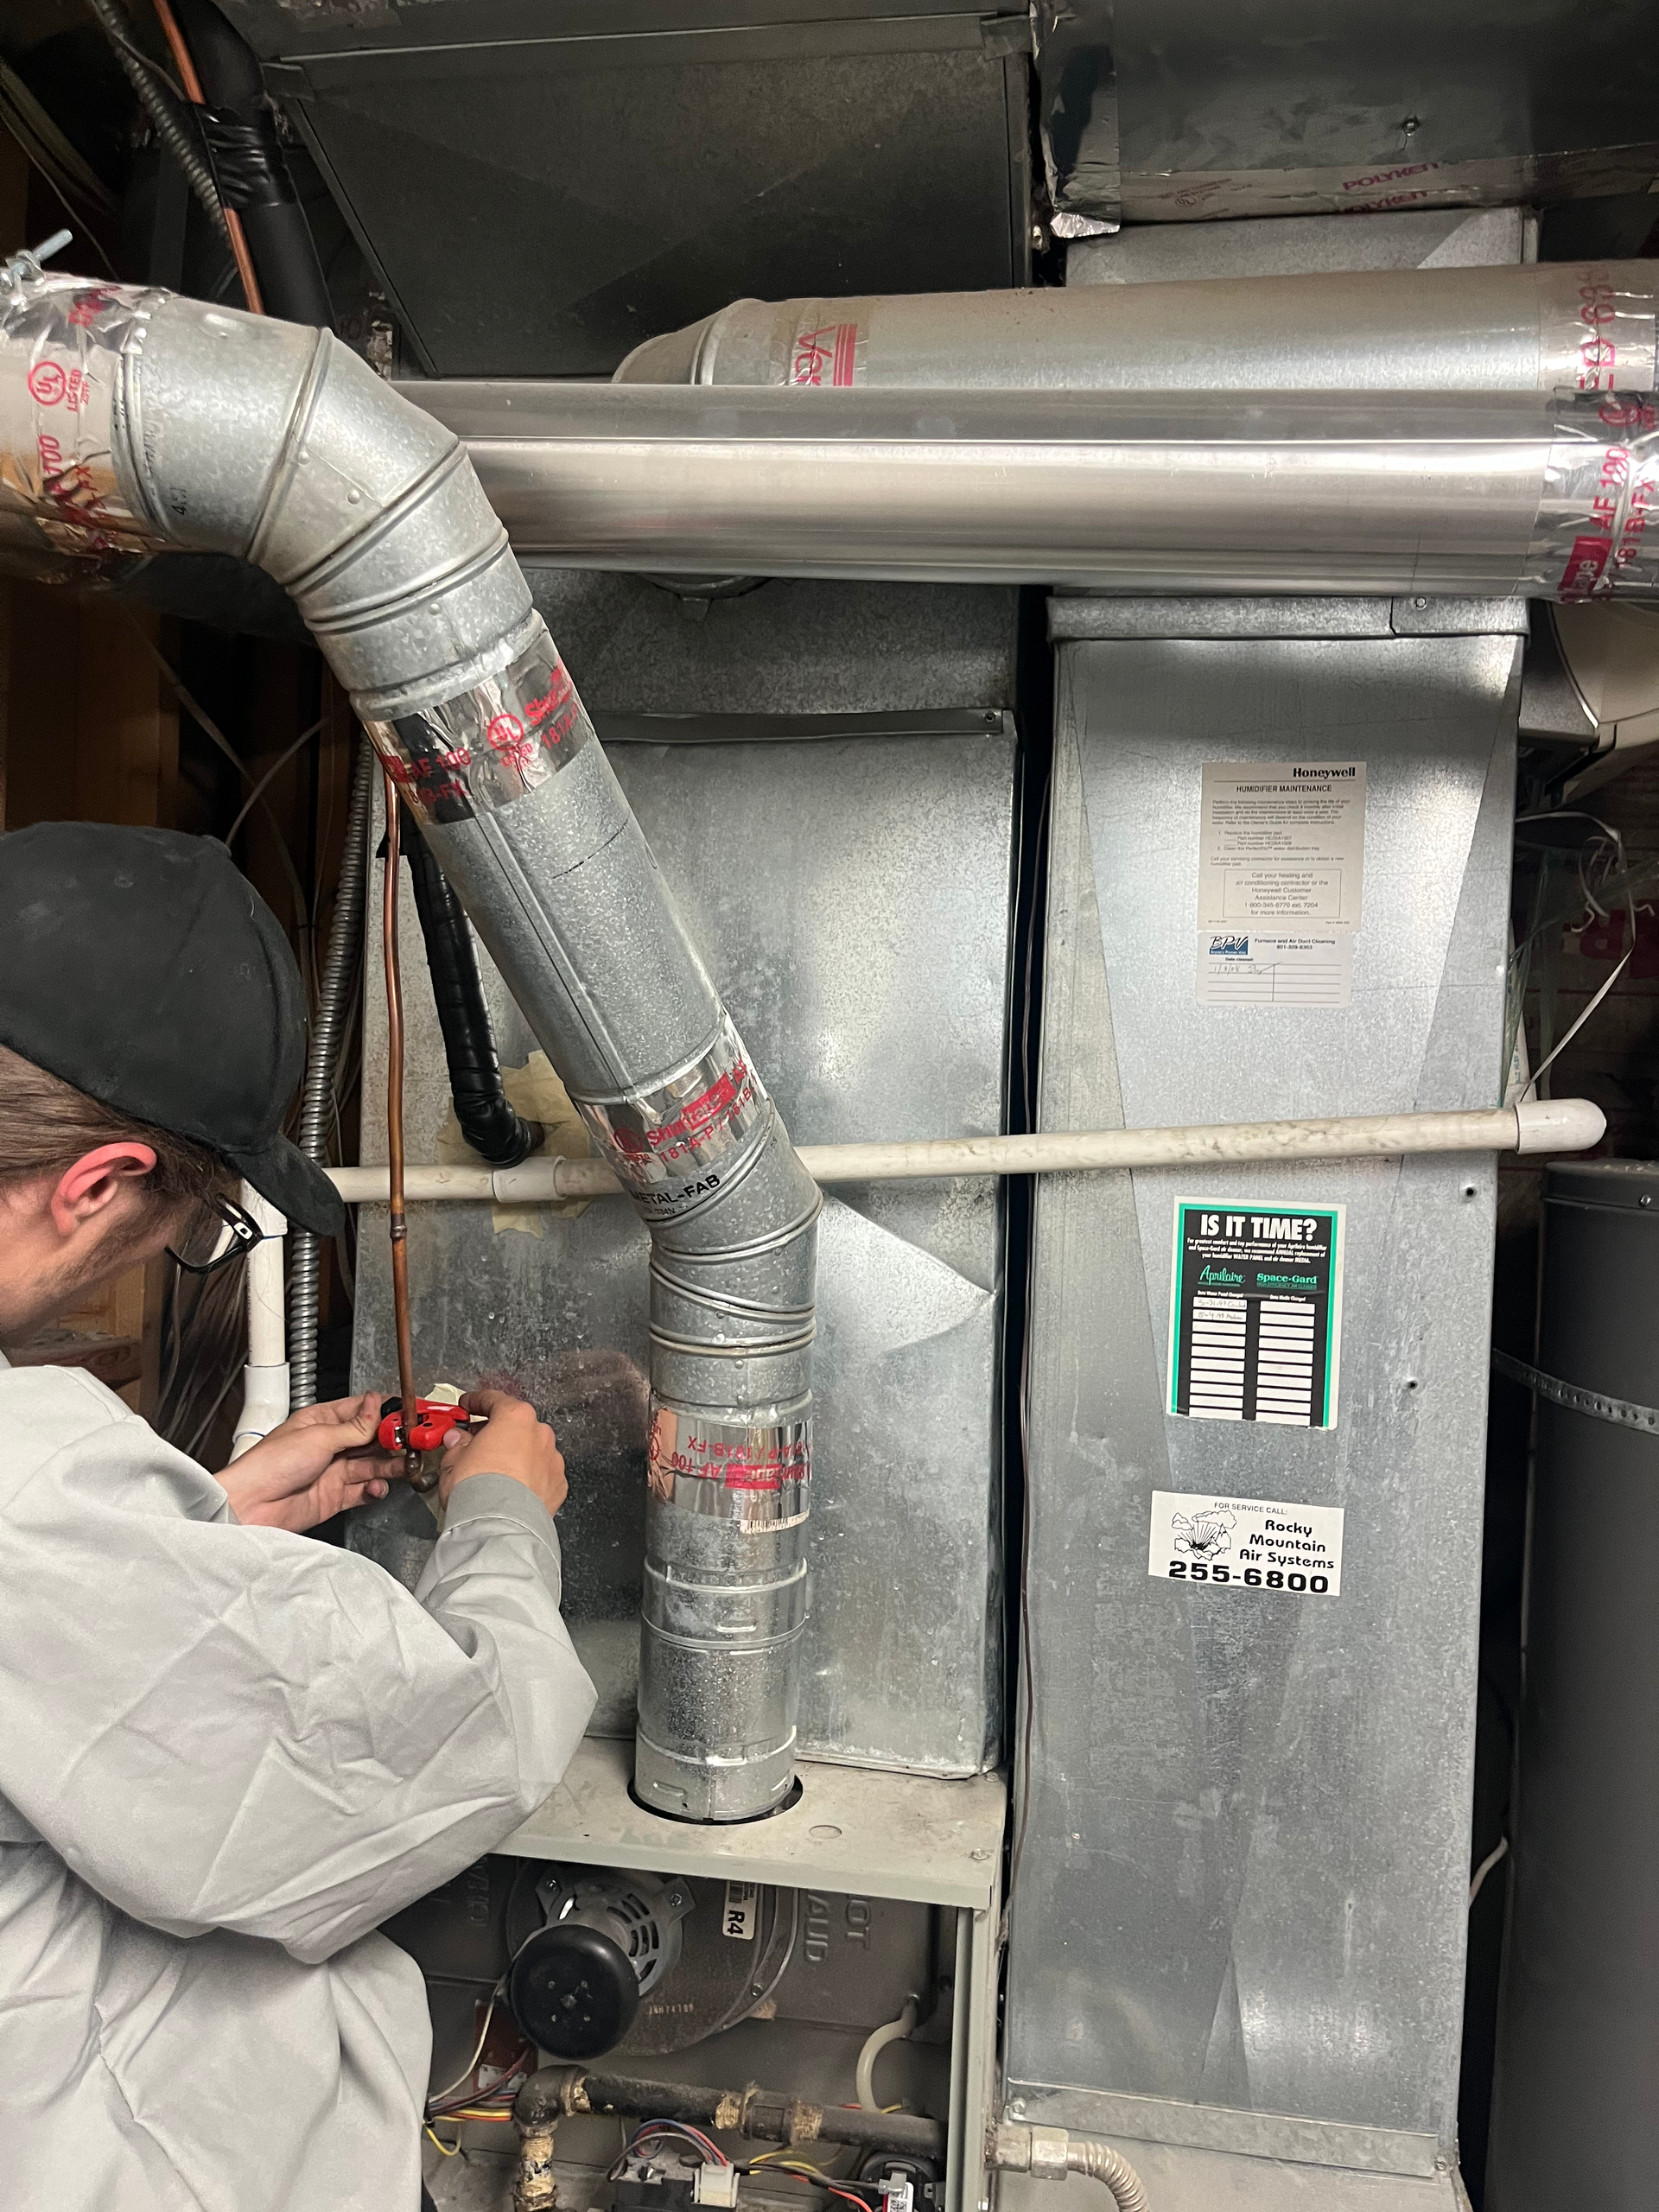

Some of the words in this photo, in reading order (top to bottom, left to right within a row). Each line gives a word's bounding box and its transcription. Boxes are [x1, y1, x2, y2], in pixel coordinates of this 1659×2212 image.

[1293, 767, 1356, 779] Honeywell
[1210, 936, 1249, 950] BPV
[1200, 1214, 1220, 1236] IS
[1225, 1216, 1246, 1237] IT
[1250, 1217, 1317, 1241] TIME?
[1199, 1264, 1246, 1286] Aprilaire
[1256, 1273, 1317, 1284] Space-Gard
[1231, 1503, 1264, 1513] SERVICE
[1265, 1519, 1313, 1537] Rocky
[1249, 1534, 1325, 1553] Mountain
[1239, 1548, 1262, 1560] Air
[1267, 1552, 1334, 1569] Systems
[1168, 1560, 1329, 1593] 255-6800
[727, 1909, 746, 1936] R4
